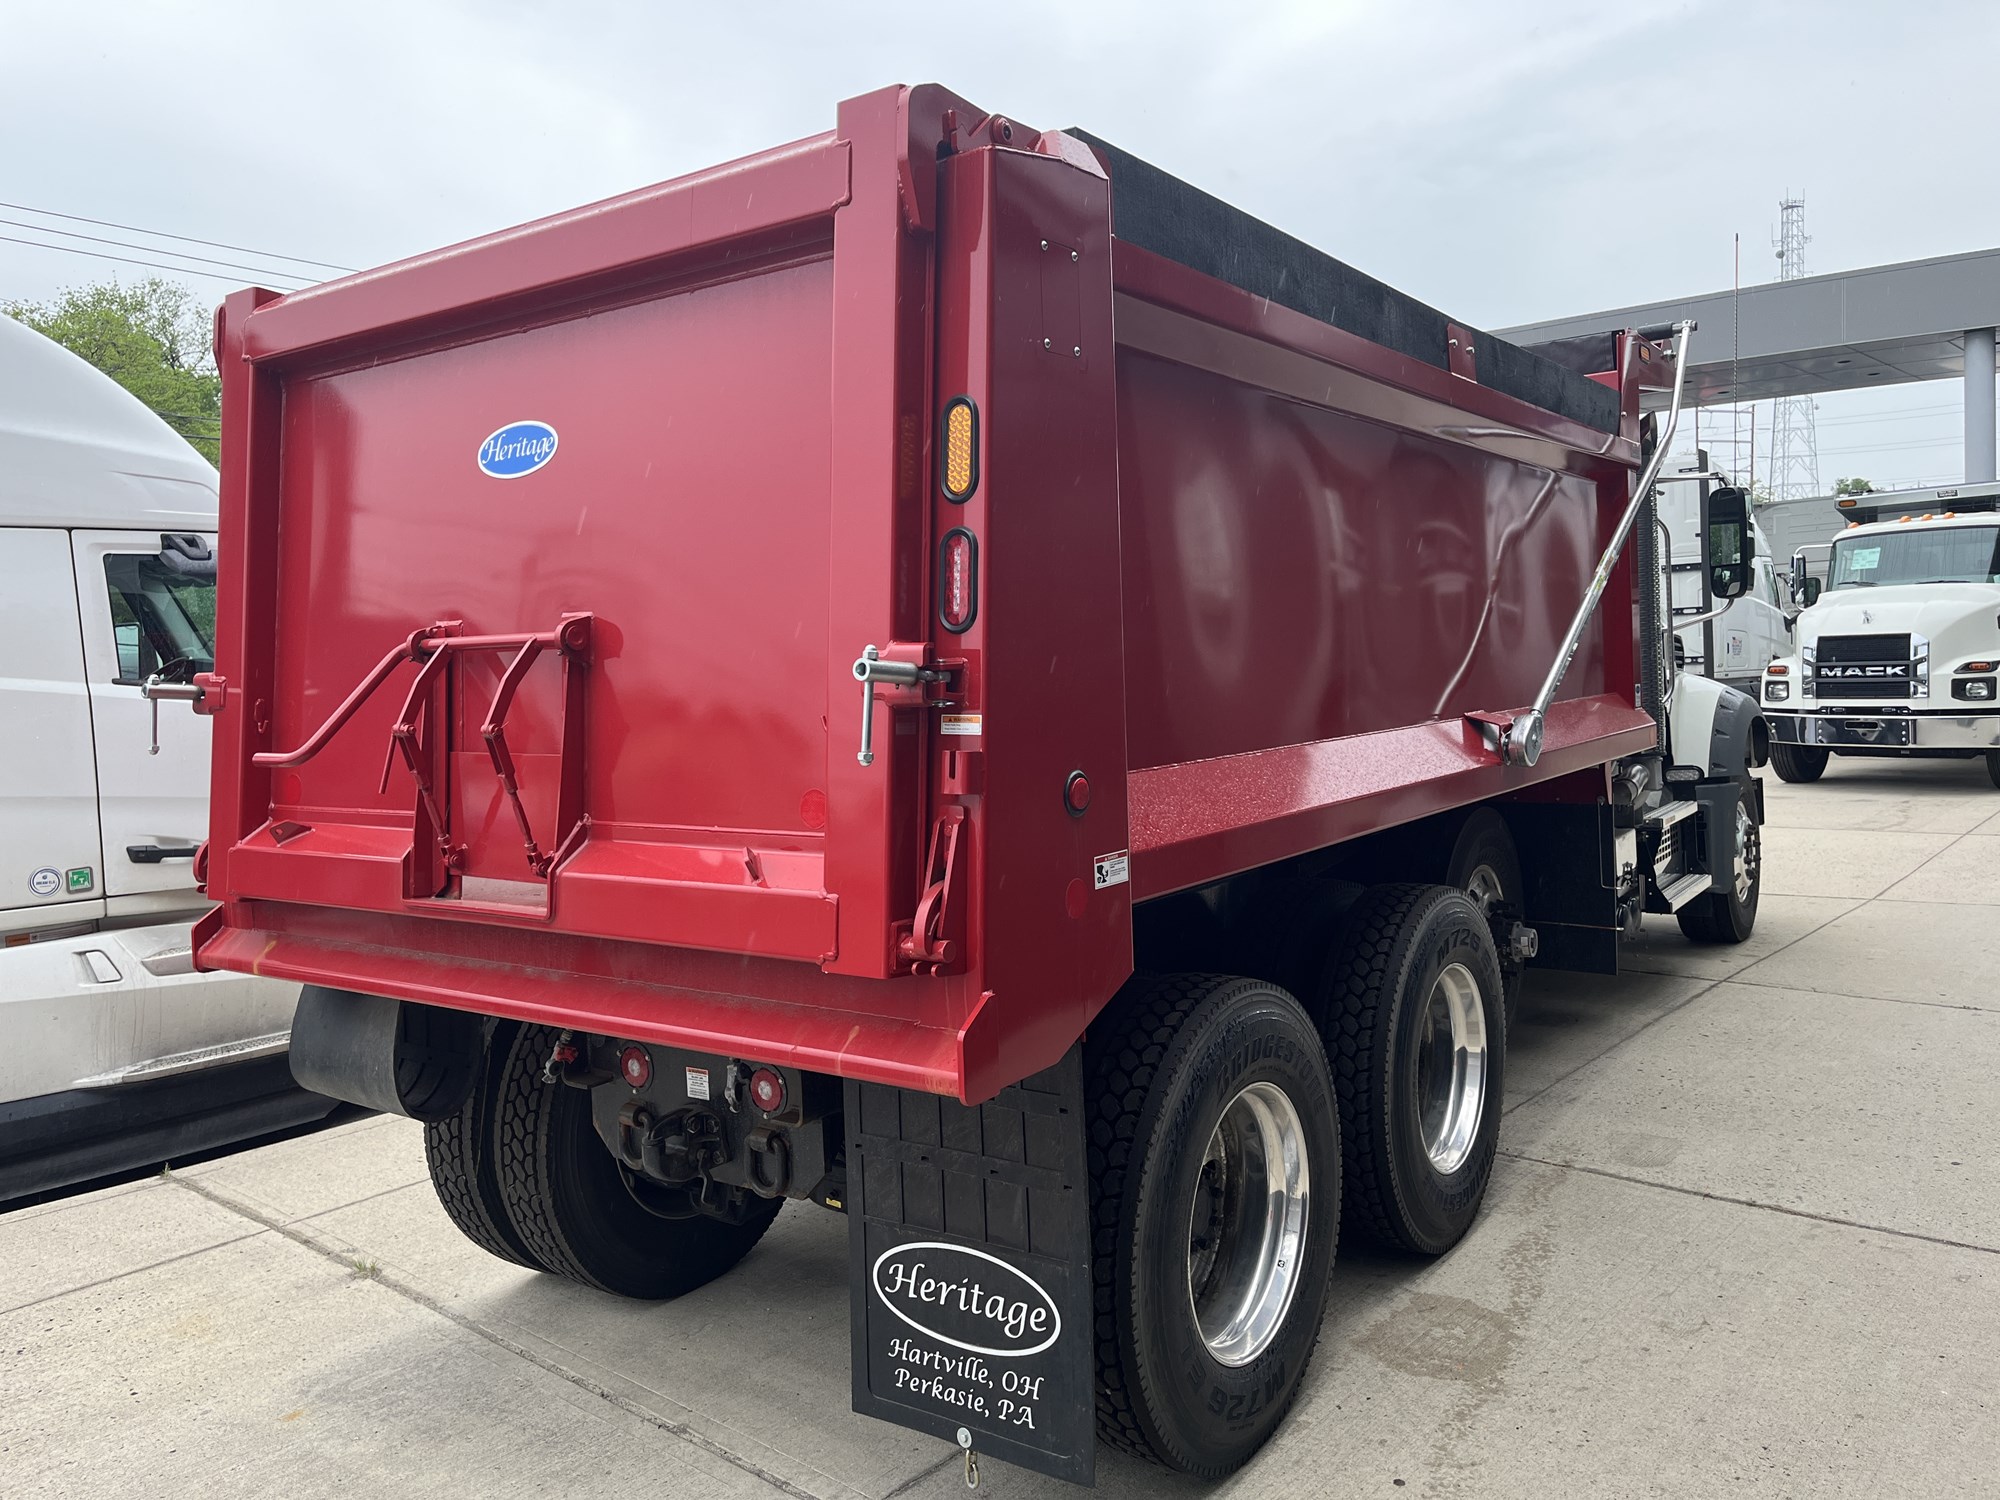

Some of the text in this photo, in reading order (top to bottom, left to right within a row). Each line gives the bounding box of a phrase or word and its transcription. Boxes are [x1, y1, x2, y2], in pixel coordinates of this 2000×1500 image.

[481, 433, 554, 464] Heritage
[1820, 665, 1906, 677] MACK
[885, 1263, 1047, 1339] Heritage
[888, 1338, 1045, 1401] Hartville, OH
[895, 1368, 1036, 1430] Perkasie, PA
